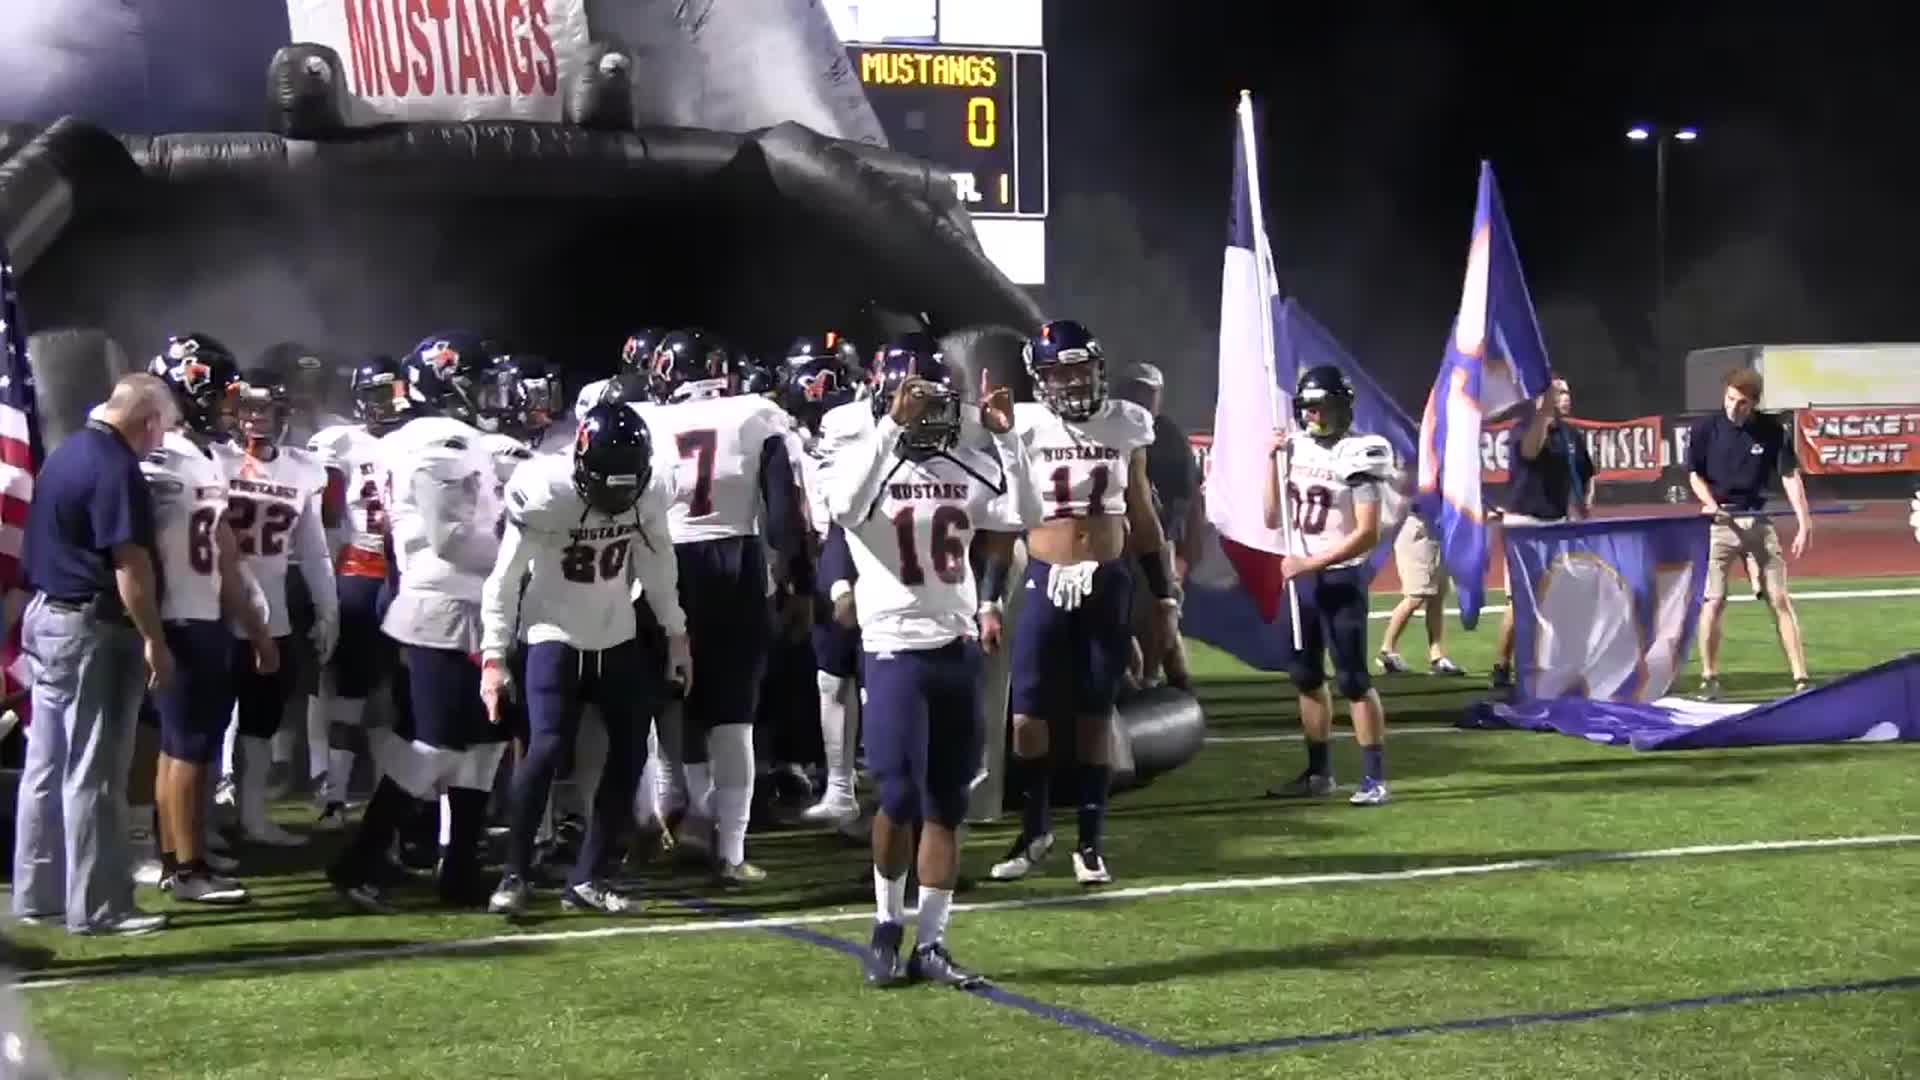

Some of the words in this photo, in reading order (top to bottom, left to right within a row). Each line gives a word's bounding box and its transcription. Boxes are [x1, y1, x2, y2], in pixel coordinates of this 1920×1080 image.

[344, 0, 557, 97] MUSTANGS
[861, 53, 997, 87] MUSTANGS
[967, 96, 996, 147] 0
[675, 428, 718, 517] 7
[1820, 443, 1908, 464] FIGHT
[889, 483, 969, 500] MUSTANGS
[227, 496, 299, 557] 22
[891, 505, 970, 587] 16
